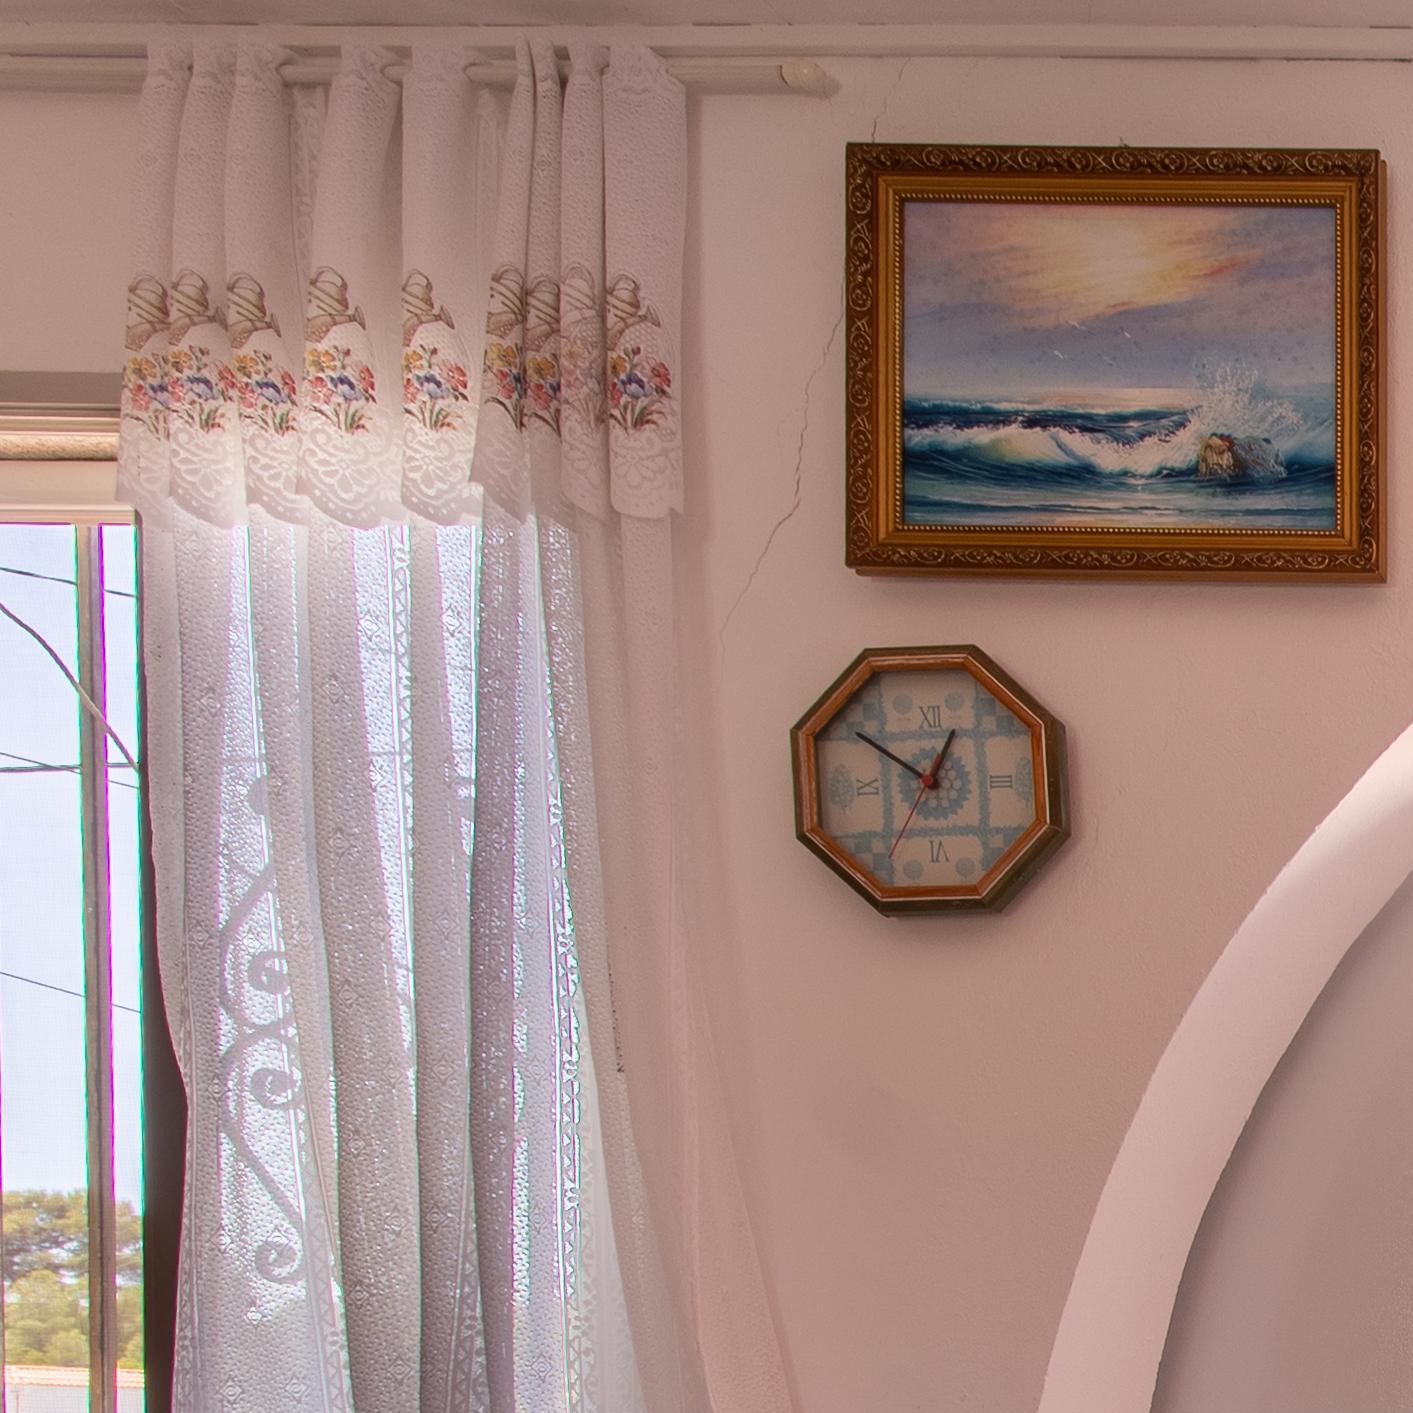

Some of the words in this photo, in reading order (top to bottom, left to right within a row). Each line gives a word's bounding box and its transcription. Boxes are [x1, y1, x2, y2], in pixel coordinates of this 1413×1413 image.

[919, 704, 942, 729] XII
[855, 777, 880, 797] IX
[989, 774, 1014, 790] III
[928, 839, 950, 864] VI
